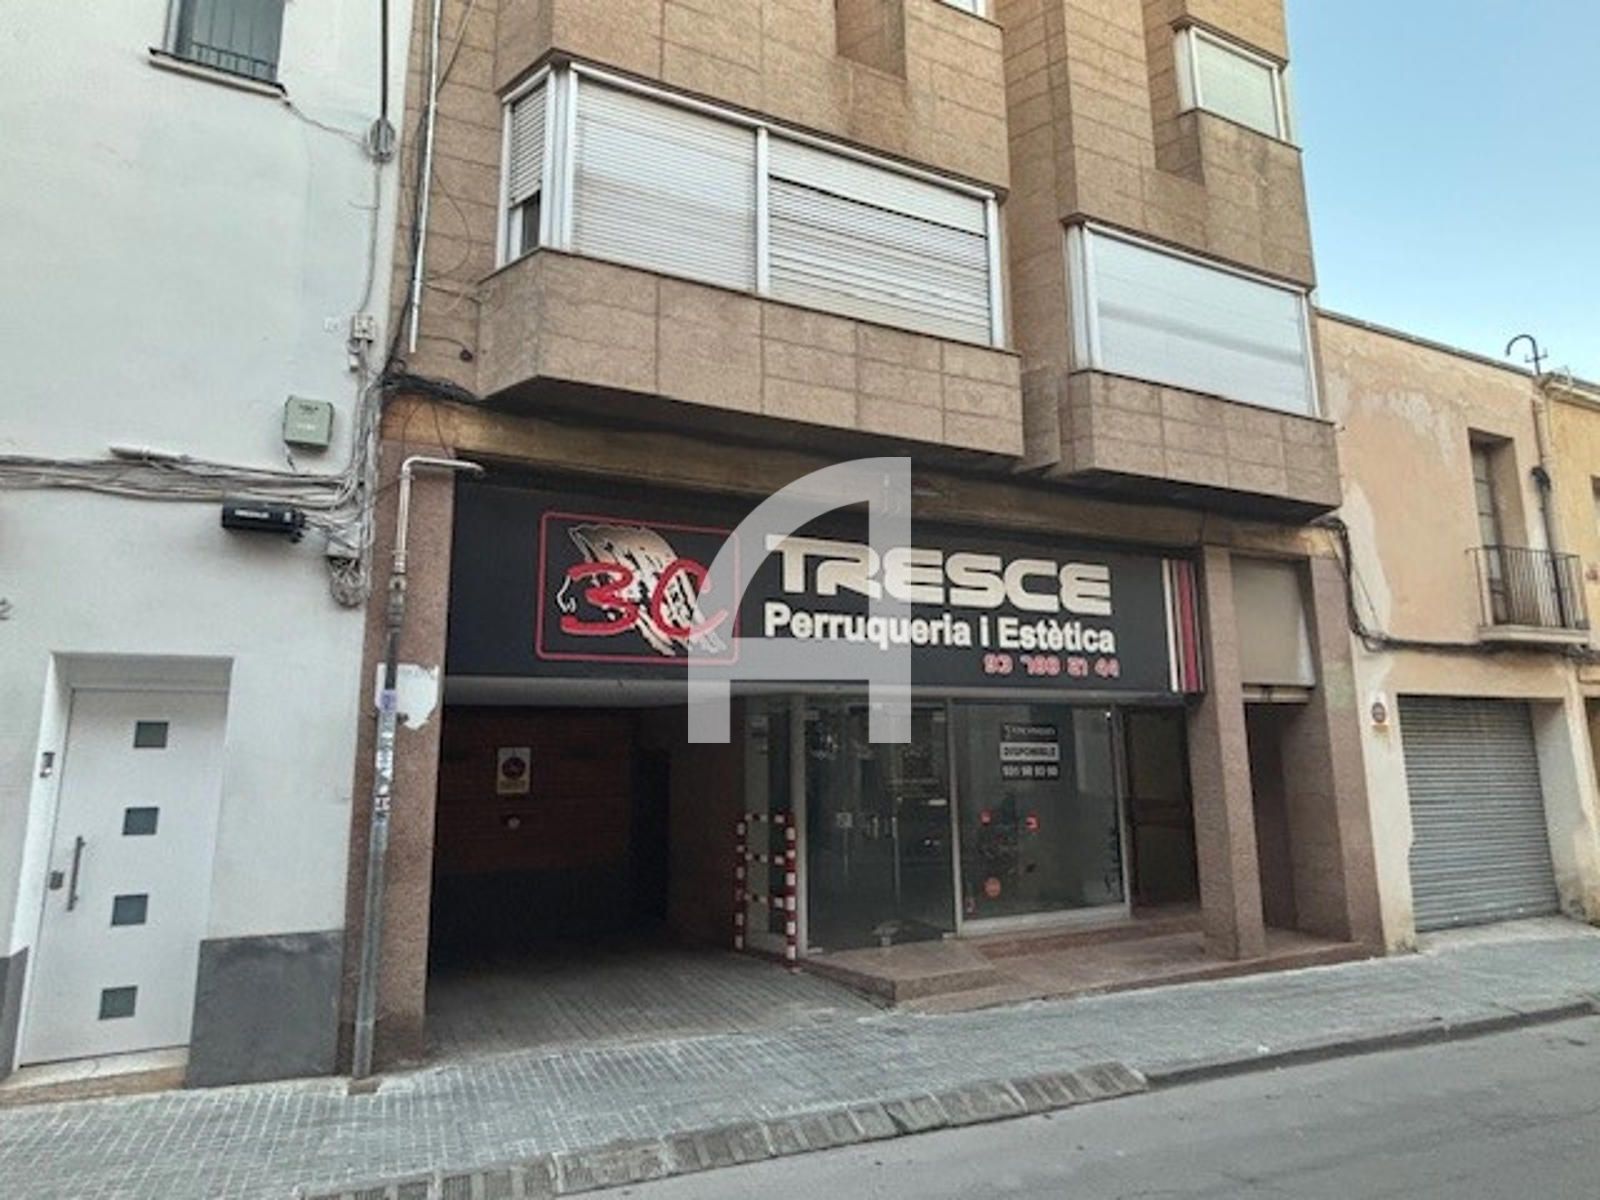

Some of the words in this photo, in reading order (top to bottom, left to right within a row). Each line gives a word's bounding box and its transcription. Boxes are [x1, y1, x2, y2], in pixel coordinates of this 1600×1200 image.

[765, 534, 1111, 616] TRESCE
[764, 601, 972, 650] Perruqueria
[997, 616, 1116, 654] Estètica
